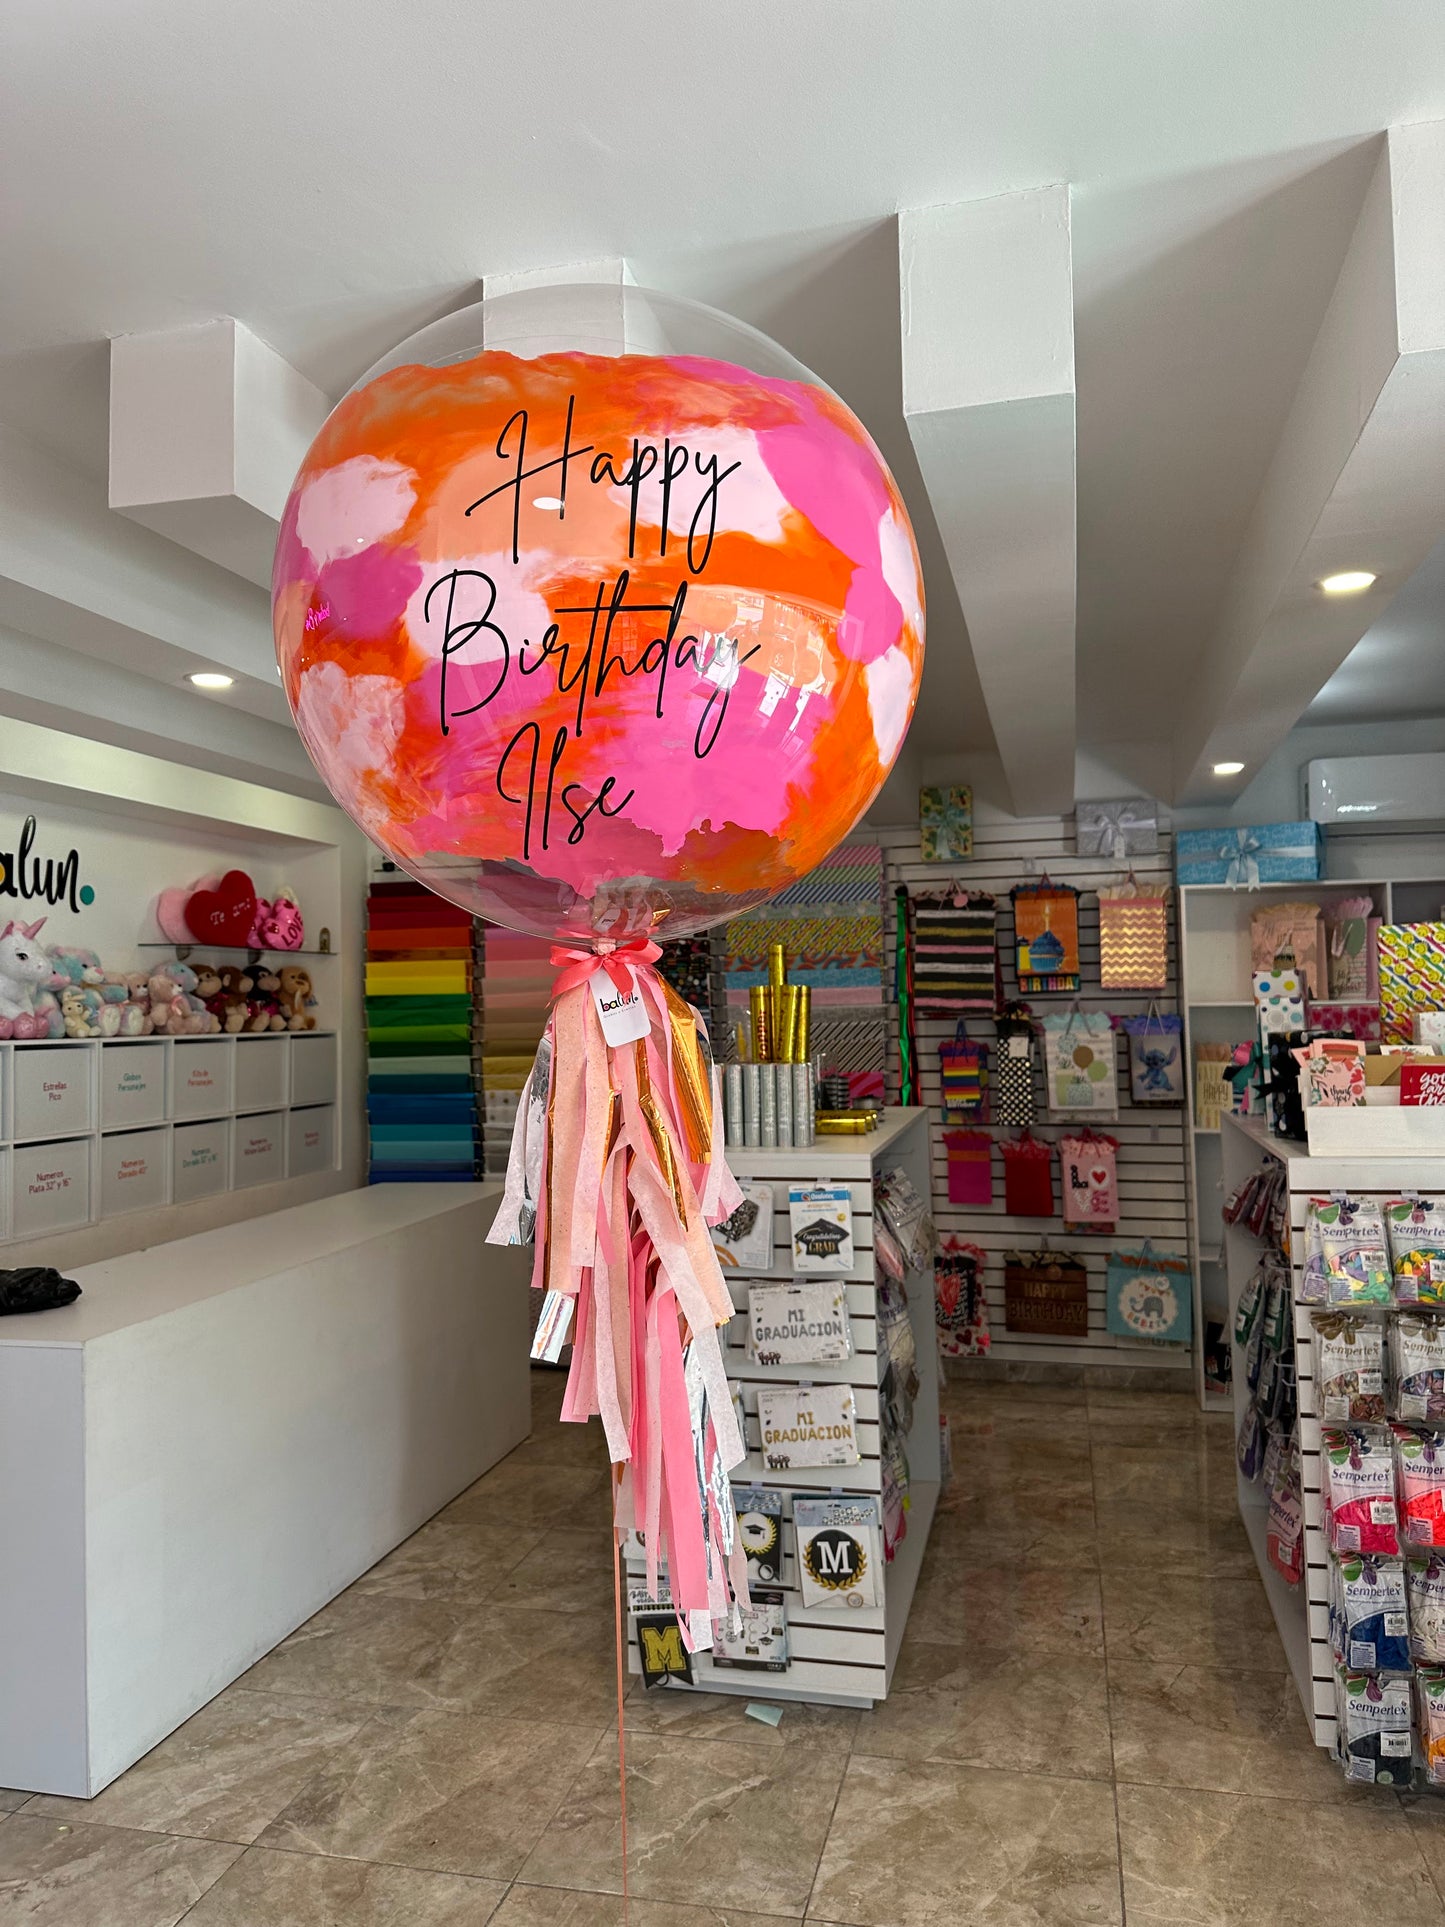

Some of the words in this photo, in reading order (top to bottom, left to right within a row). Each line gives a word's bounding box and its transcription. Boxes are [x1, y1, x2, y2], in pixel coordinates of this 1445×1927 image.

[466, 395, 741, 574] Happy
[424, 569, 761, 759] Birthday
[497, 722, 634, 860] Ilse
[1020, 976, 1080, 992] BIRTHDAY
[43, 1082, 67, 1092] Estrellas
[48, 1092, 62, 1101] Pico
[36, 1170, 64, 1182] Numeros
[28, 1184, 45, 1194] Plata
[56, 1182, 61, 1190] y
[1322, 1226, 1380, 1239] Sempertex
[808, 1241, 836, 1253] GRAD
[788, 1308, 806, 1323] MI
[1009, 1300, 1086, 1322] BIRTHDAY
[755, 1321, 842, 1342] GRADUACION
[1323, 1343, 1379, 1357] Sempertex
[796, 1411, 815, 1426] MI
[764, 1424, 852, 1444] GRADUACION
[1331, 1468, 1390, 1484] Sempertex
[816, 1540, 854, 1574] M
[1346, 1584, 1401, 1599] Sempertex
[640, 1625, 687, 1673] M
[1348, 1700, 1408, 1716] Sempertex
